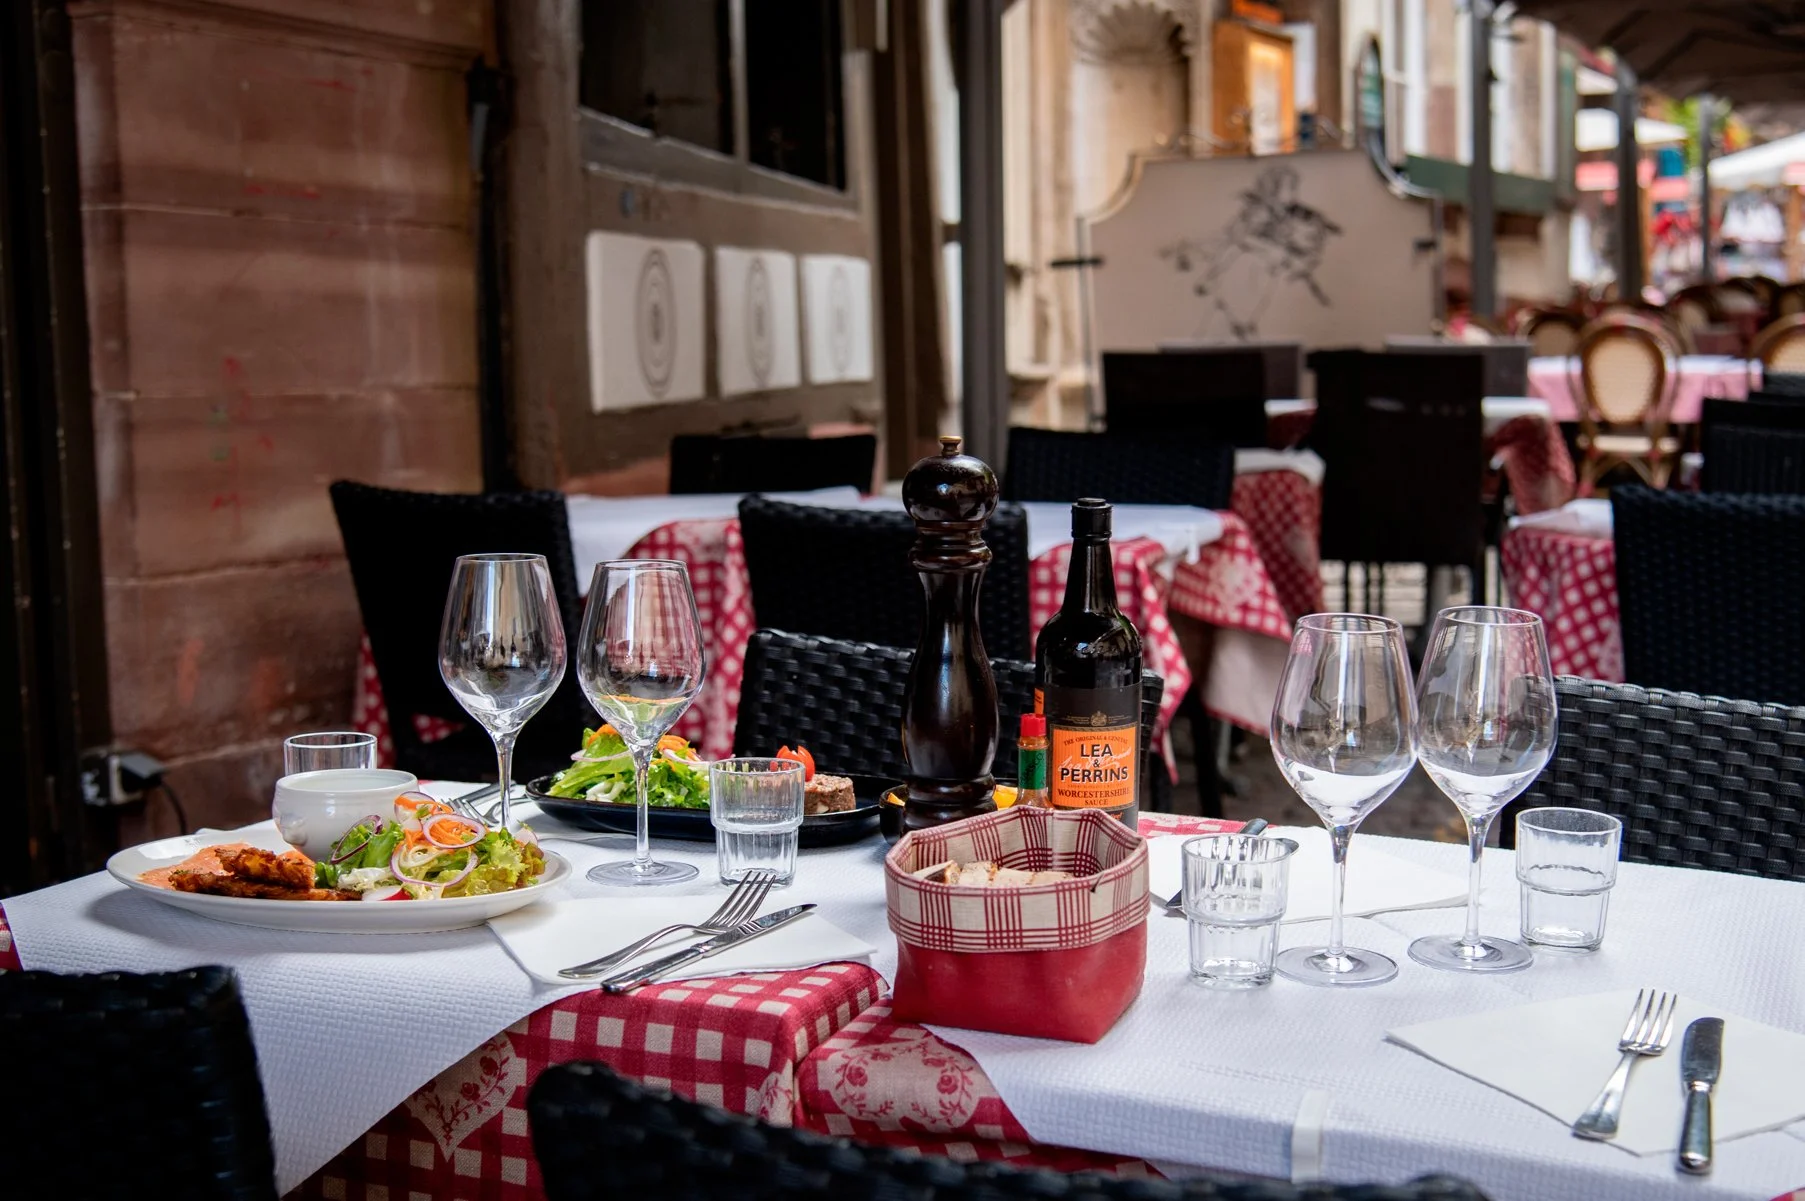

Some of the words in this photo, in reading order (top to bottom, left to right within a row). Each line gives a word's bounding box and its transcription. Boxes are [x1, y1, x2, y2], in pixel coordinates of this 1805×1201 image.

[1075, 735, 1102, 743] ORIGINAL
[1081, 744, 1113, 757] LEA
[1093, 759, 1100, 768] &
[1061, 767, 1128, 783] PERRINS
[1057, 787, 1130, 798] WORCESTERSHIRE
